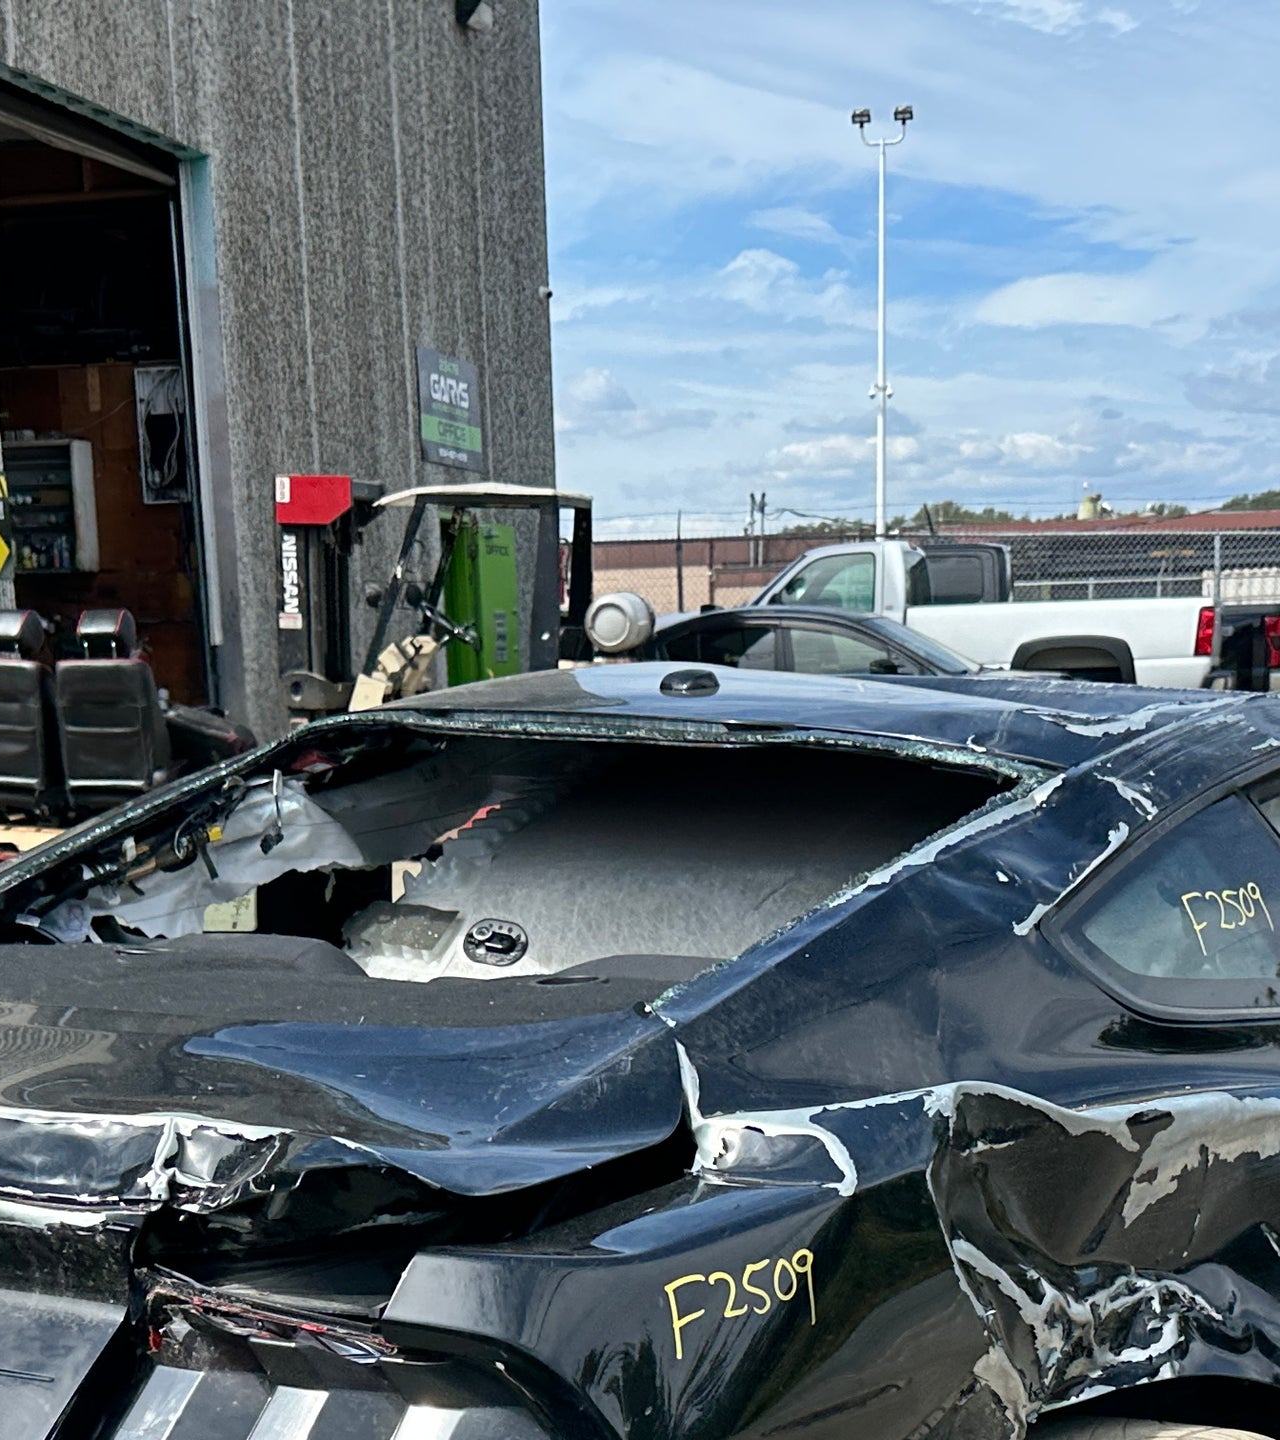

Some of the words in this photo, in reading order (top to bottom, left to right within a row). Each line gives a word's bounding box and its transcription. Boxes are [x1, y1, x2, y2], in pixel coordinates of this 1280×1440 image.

[281, 534, 300, 614] NISSAN
[1180, 881, 1275, 957] F2509
[663, 1247, 817, 1361] F2509
